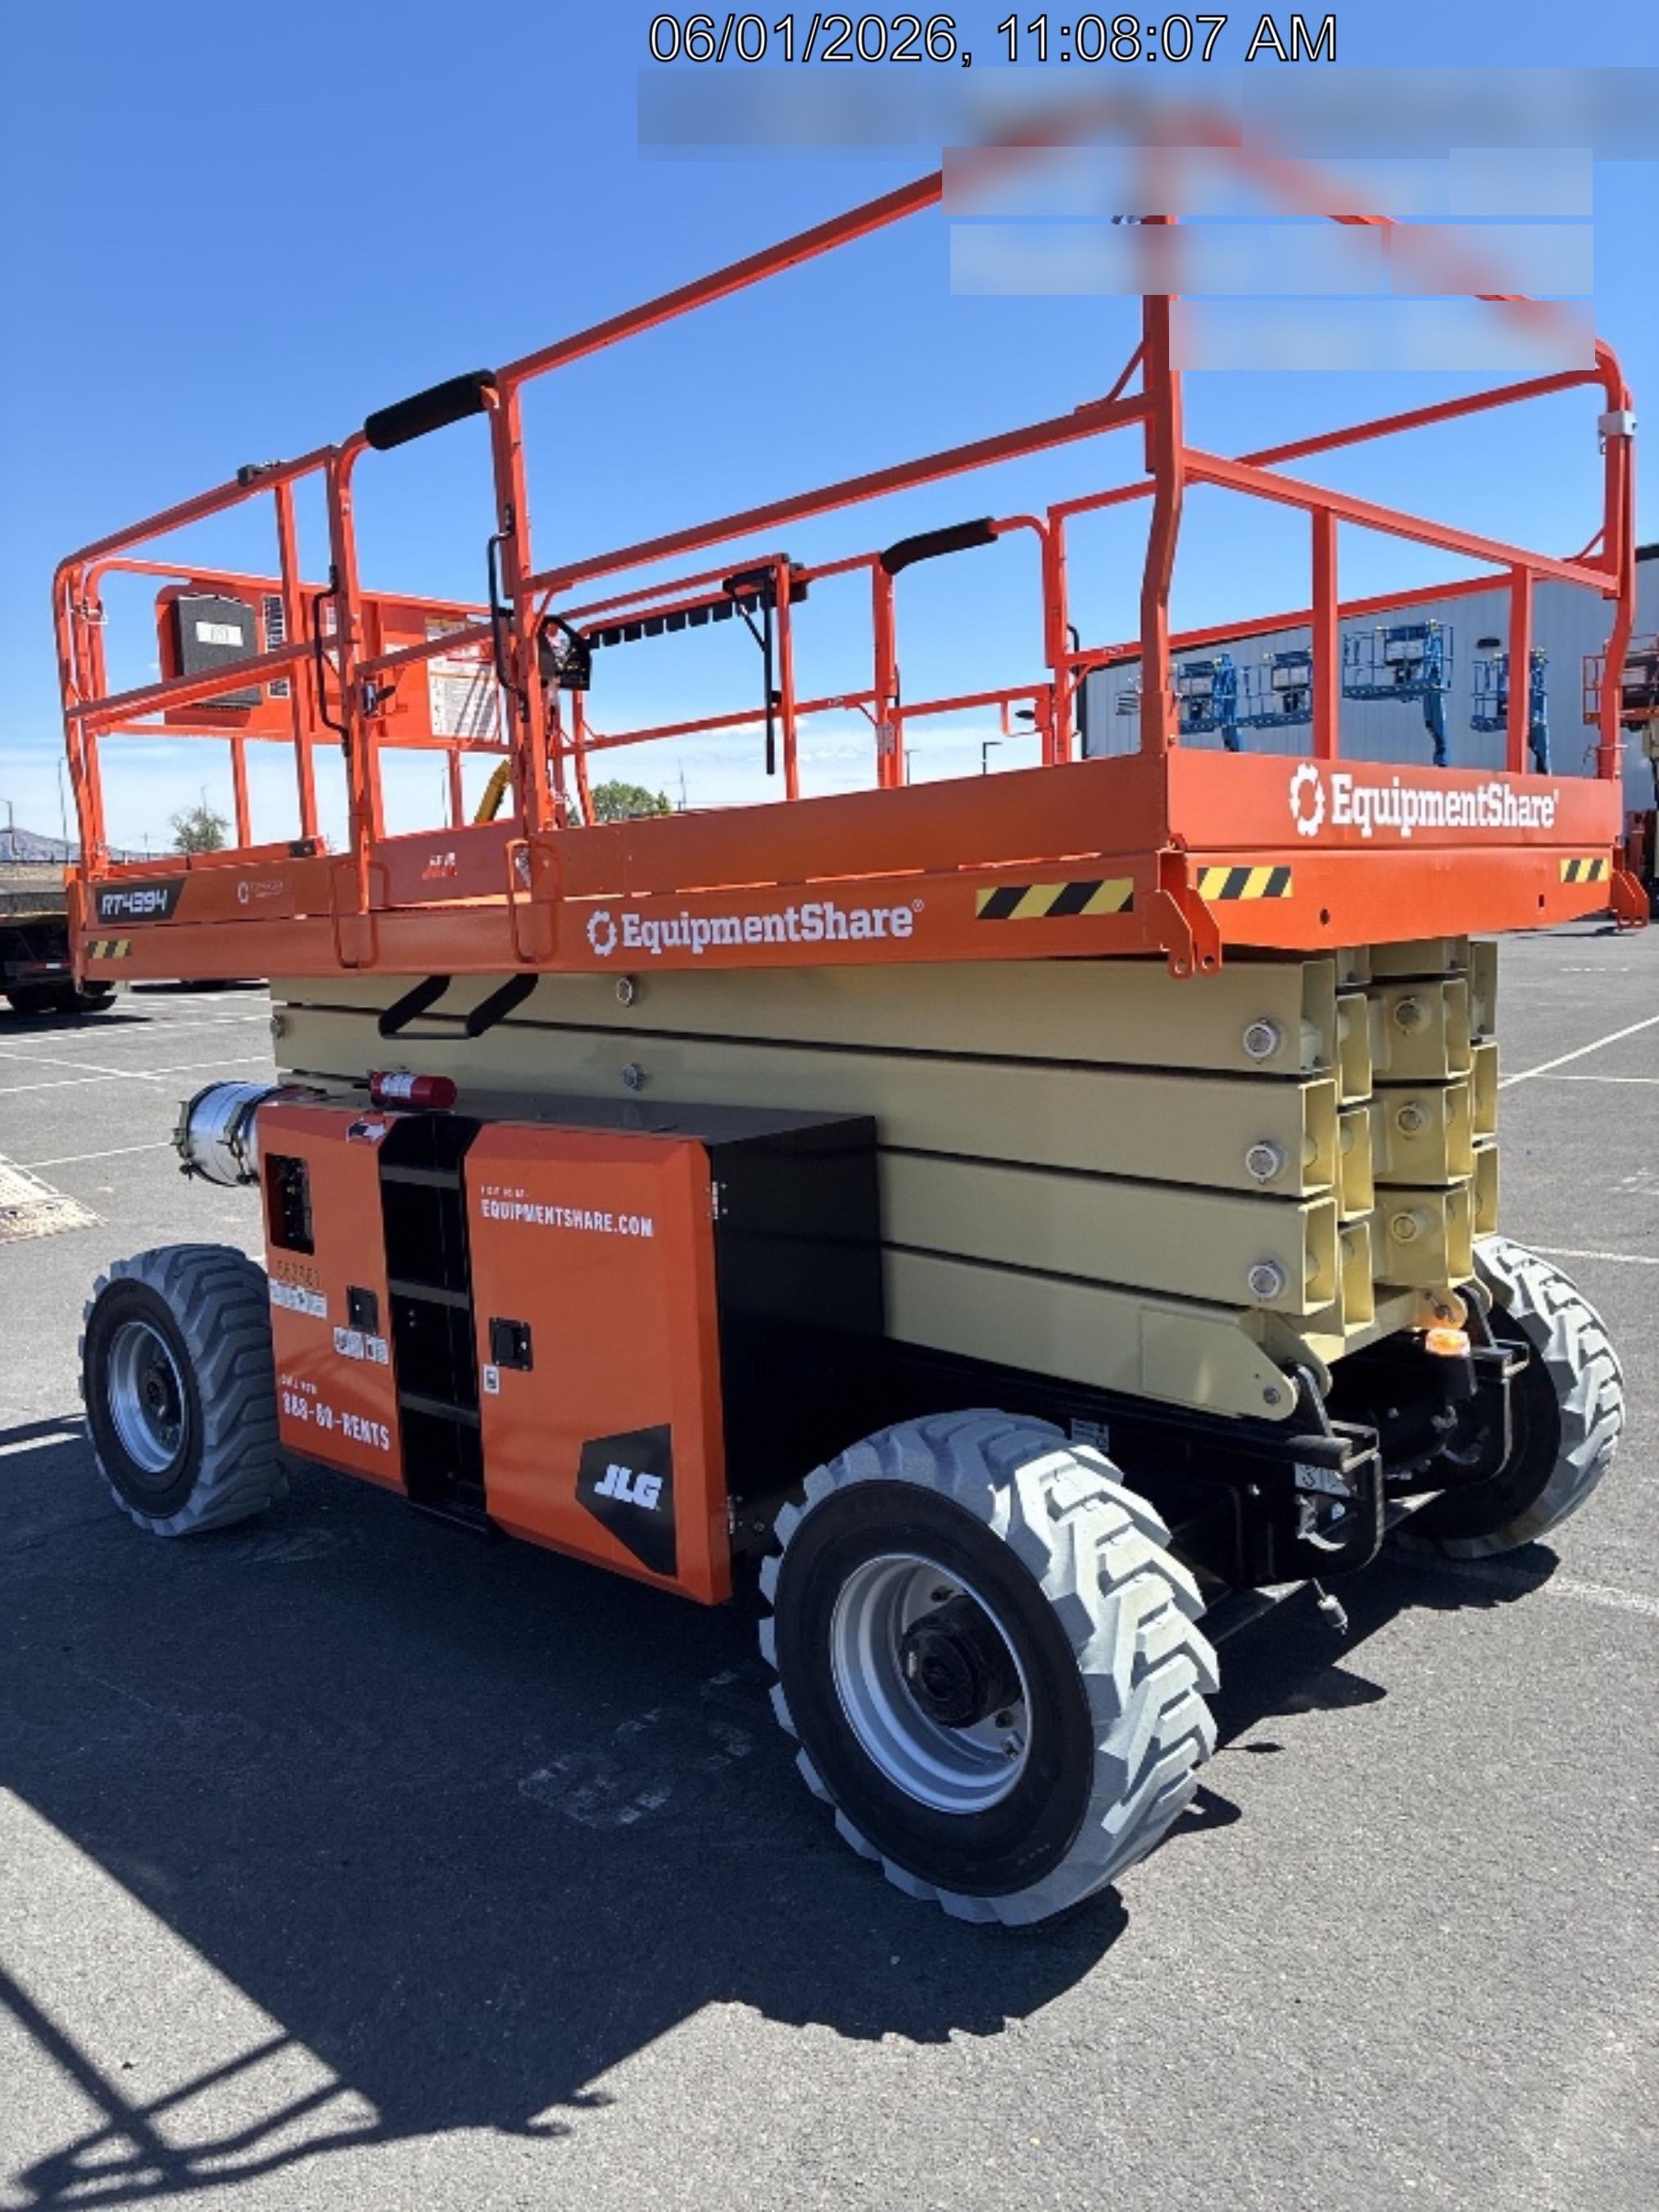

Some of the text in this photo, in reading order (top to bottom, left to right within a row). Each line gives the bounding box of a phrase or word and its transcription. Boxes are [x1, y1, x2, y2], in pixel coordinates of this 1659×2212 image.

[1330, 773, 1555, 838] EquipmentShare
[102, 889, 167, 915] RT4394
[481, 1199, 654, 1237] EQUIPMENTSHARE.COM
[593, 1463, 663, 1511] JLG
